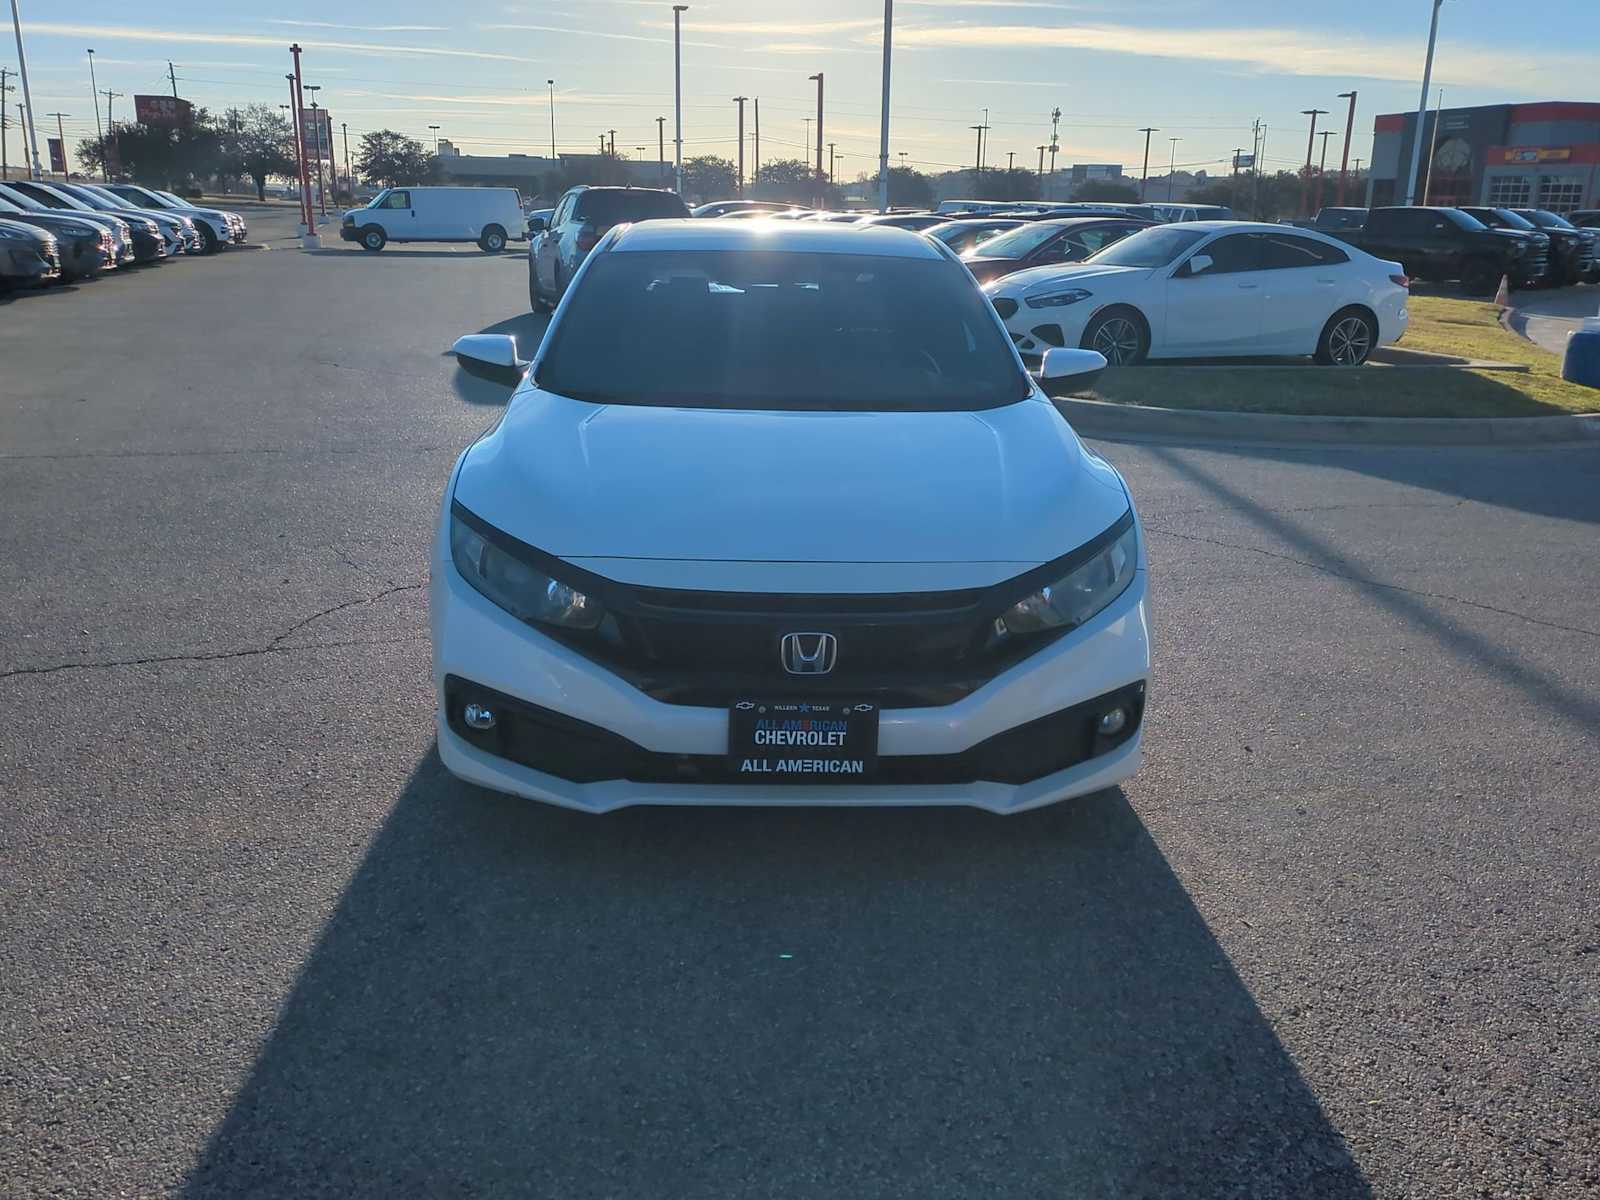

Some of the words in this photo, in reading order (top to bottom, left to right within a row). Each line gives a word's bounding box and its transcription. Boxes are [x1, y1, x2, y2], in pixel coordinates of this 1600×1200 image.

[755, 719, 778, 730] ALL
[783, 719, 848, 731] AMERICAN
[754, 730, 847, 746] CHEVROLET
[741, 759, 772, 772] ALL
[775, 759, 864, 773] AMERICAN
